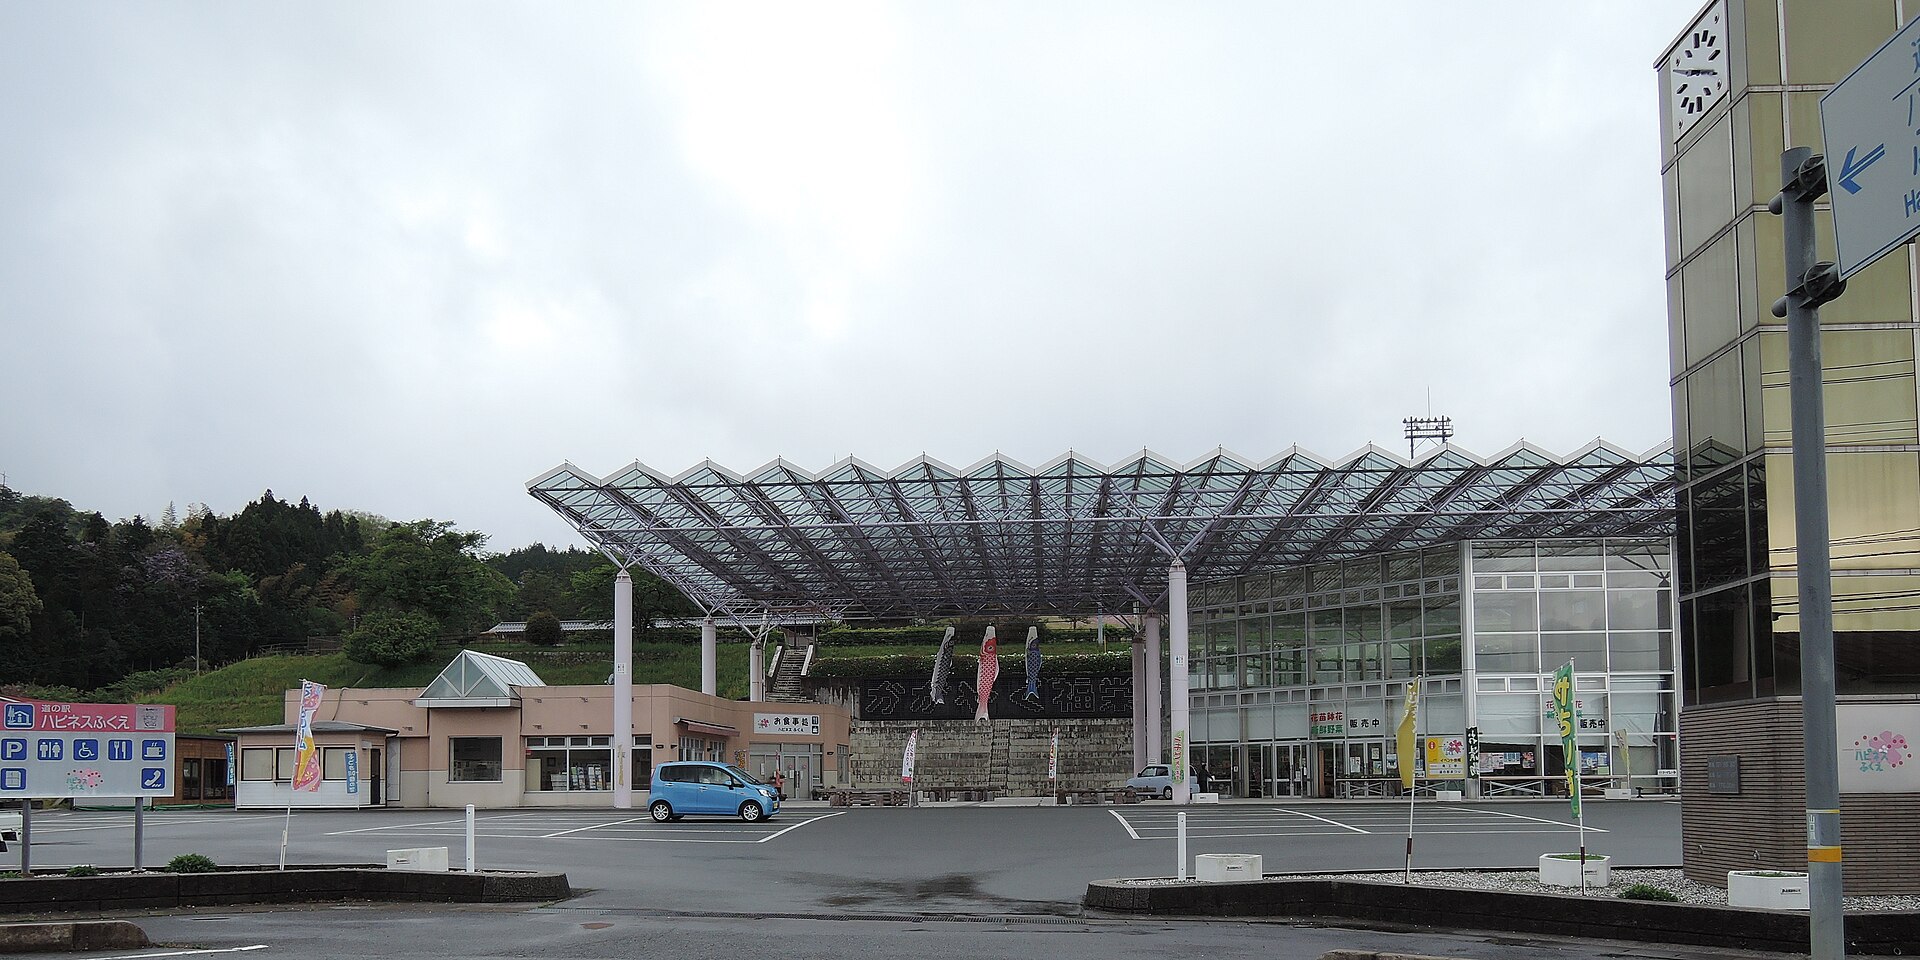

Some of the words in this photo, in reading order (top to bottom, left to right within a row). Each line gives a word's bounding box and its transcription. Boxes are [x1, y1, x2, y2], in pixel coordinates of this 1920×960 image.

[41, 704, 71, 713] 道の駅
[41, 715, 130, 729] ハピネスふくえ
[1311, 712, 1343, 722] 花苗鉢花
[1350, 718, 1380, 728] 販売中
[7, 741, 23, 758] P
[1855, 749, 1889, 761] ハピネス
[1859, 762, 1884, 772] ふくえ
